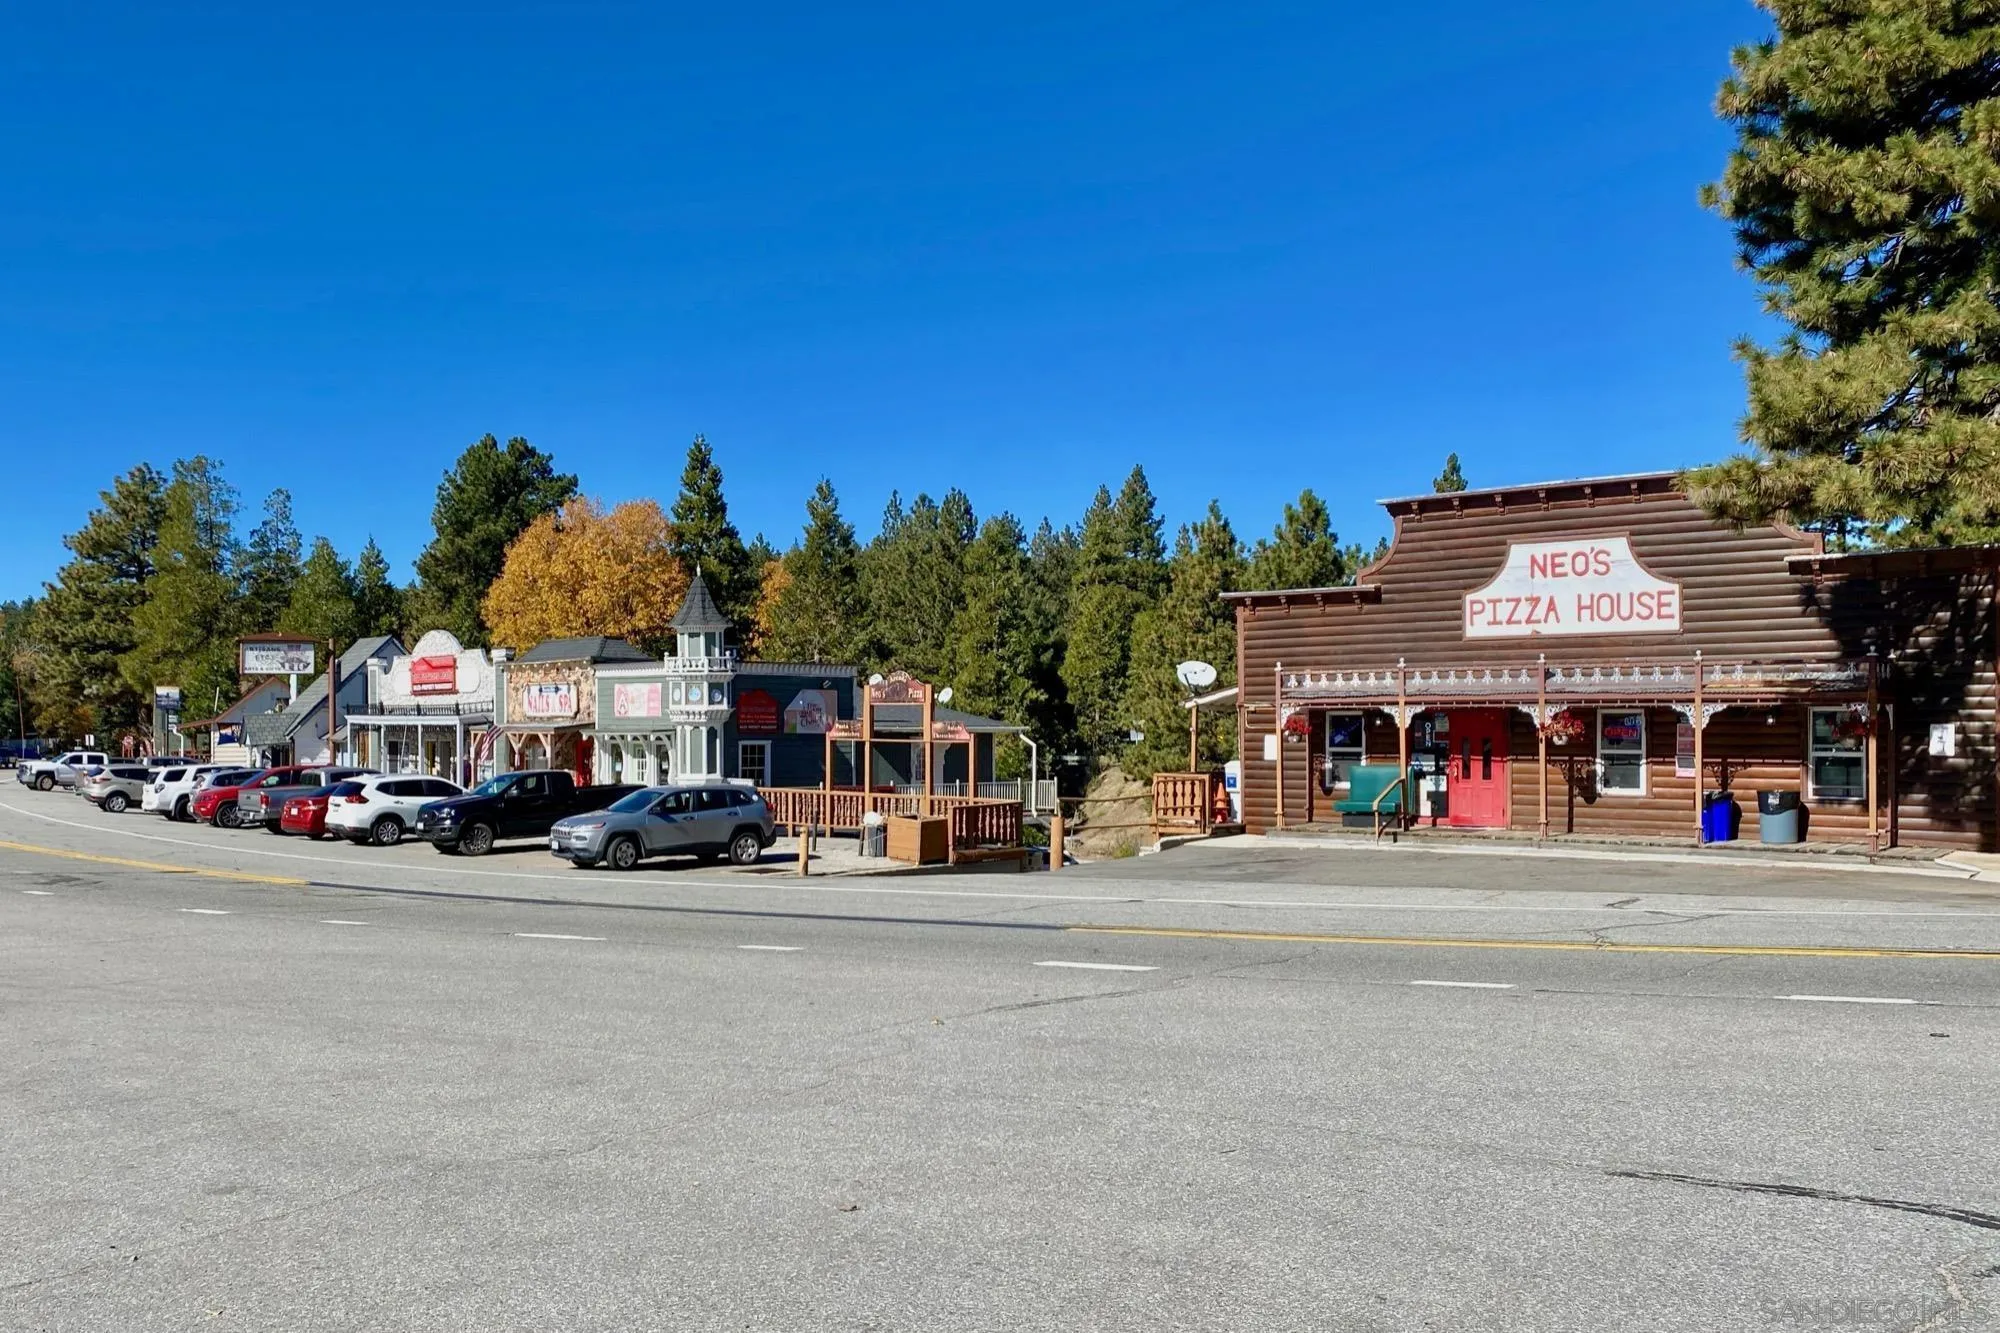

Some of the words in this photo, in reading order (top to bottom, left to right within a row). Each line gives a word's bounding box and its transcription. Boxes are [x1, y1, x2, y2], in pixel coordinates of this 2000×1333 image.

[1530, 547, 1611, 579] NEO'S
[1469, 595, 1561, 626] PIZZA
[1577, 590, 1676, 622] HOUSE
[908, 687, 924, 698] Pizza
[528, 695, 550, 713] NAILS
[559, 693, 573, 712] SPA
[1604, 727, 1637, 738] OPEN
